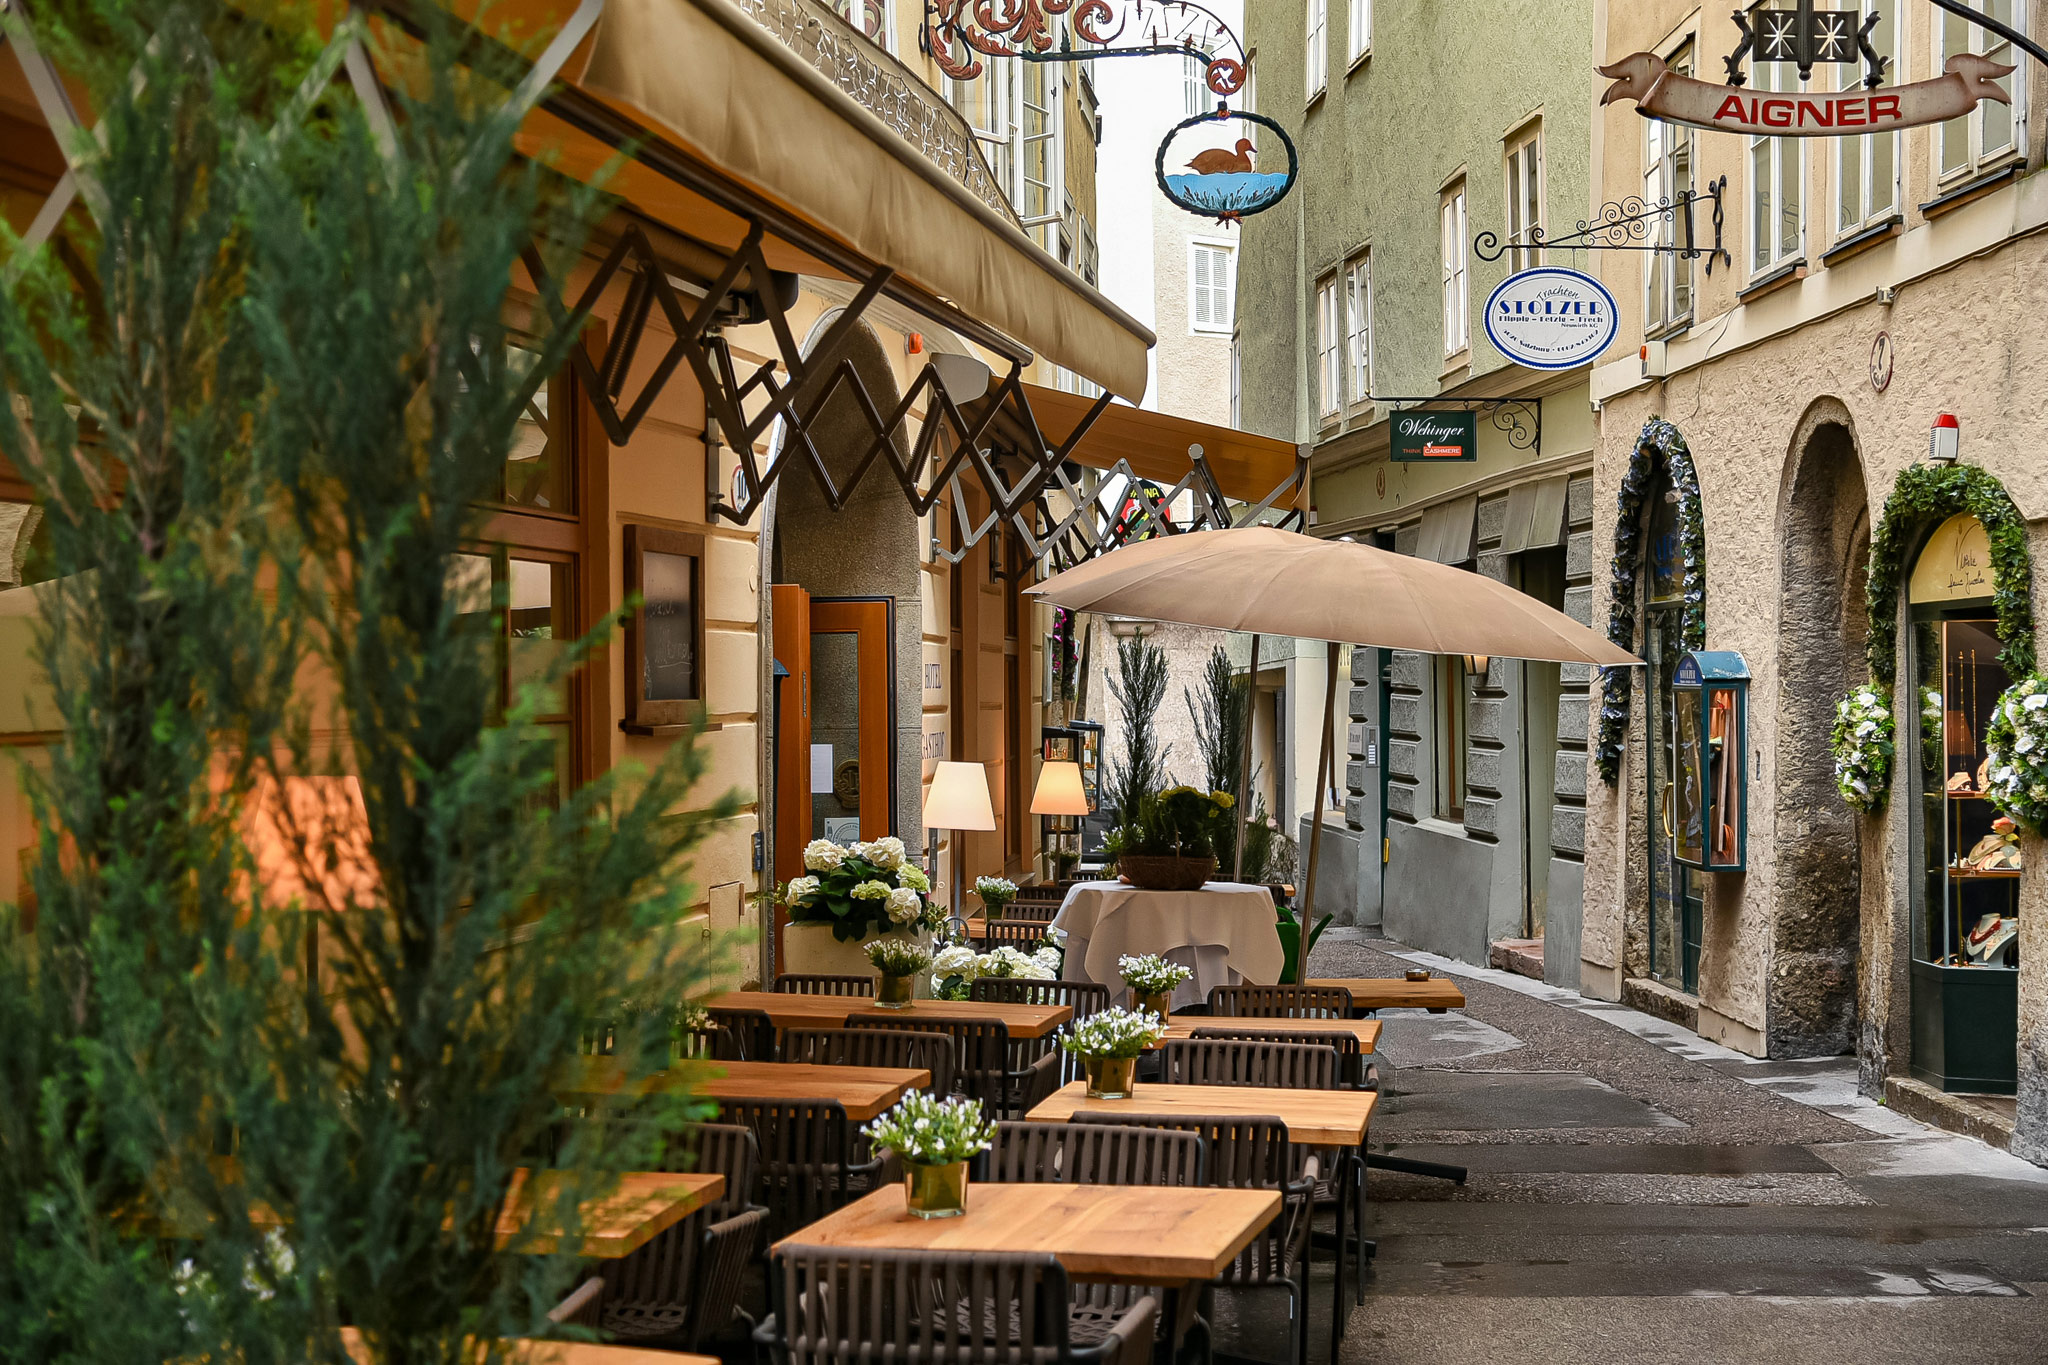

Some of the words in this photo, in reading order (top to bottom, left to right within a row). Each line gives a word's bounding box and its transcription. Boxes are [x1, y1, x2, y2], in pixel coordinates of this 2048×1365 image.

[1712, 95, 1903, 128] AIGNER
[1536, 285, 1580, 302] Trachten
[1499, 300, 1603, 315] STOLZER
[925, 664, 941, 688] HOTEL
